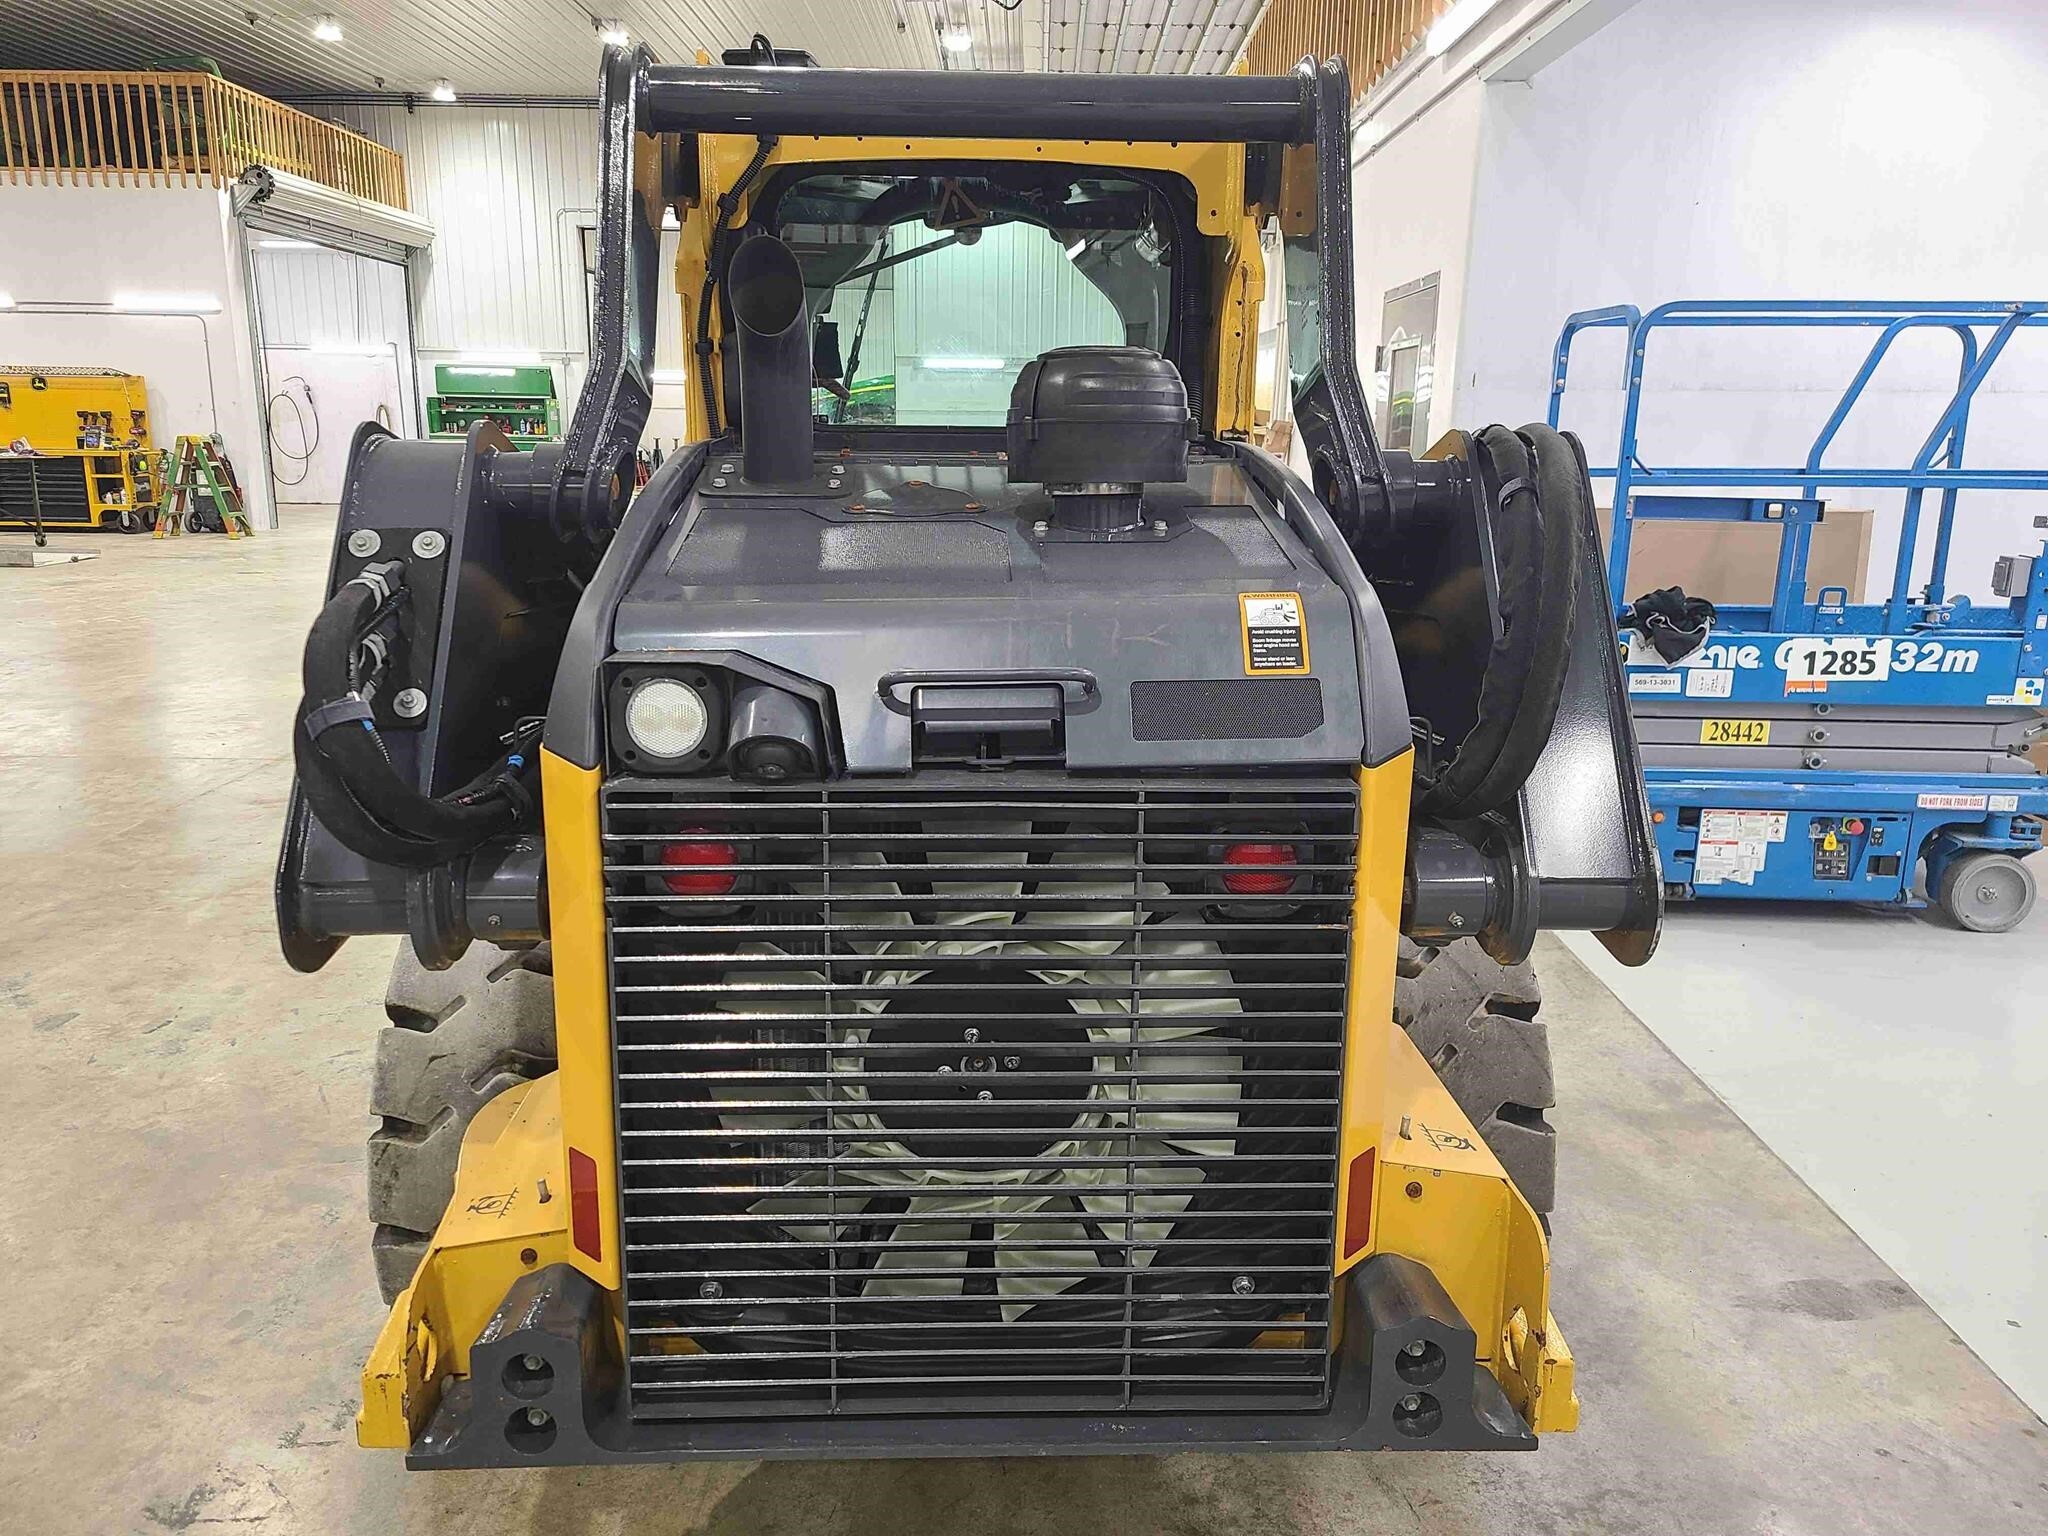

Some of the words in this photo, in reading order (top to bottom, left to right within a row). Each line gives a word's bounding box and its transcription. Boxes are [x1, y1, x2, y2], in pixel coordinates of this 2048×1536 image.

[1803, 650, 1876, 676] 1285
[1708, 721, 1764, 742] 28442
[1920, 797, 1928, 806] DO
[1928, 797, 1939, 806] NOT
[1939, 797, 1953, 807] FORK
[1953, 797, 1968, 807] FROM
[1968, 798, 1984, 807] SIDES
